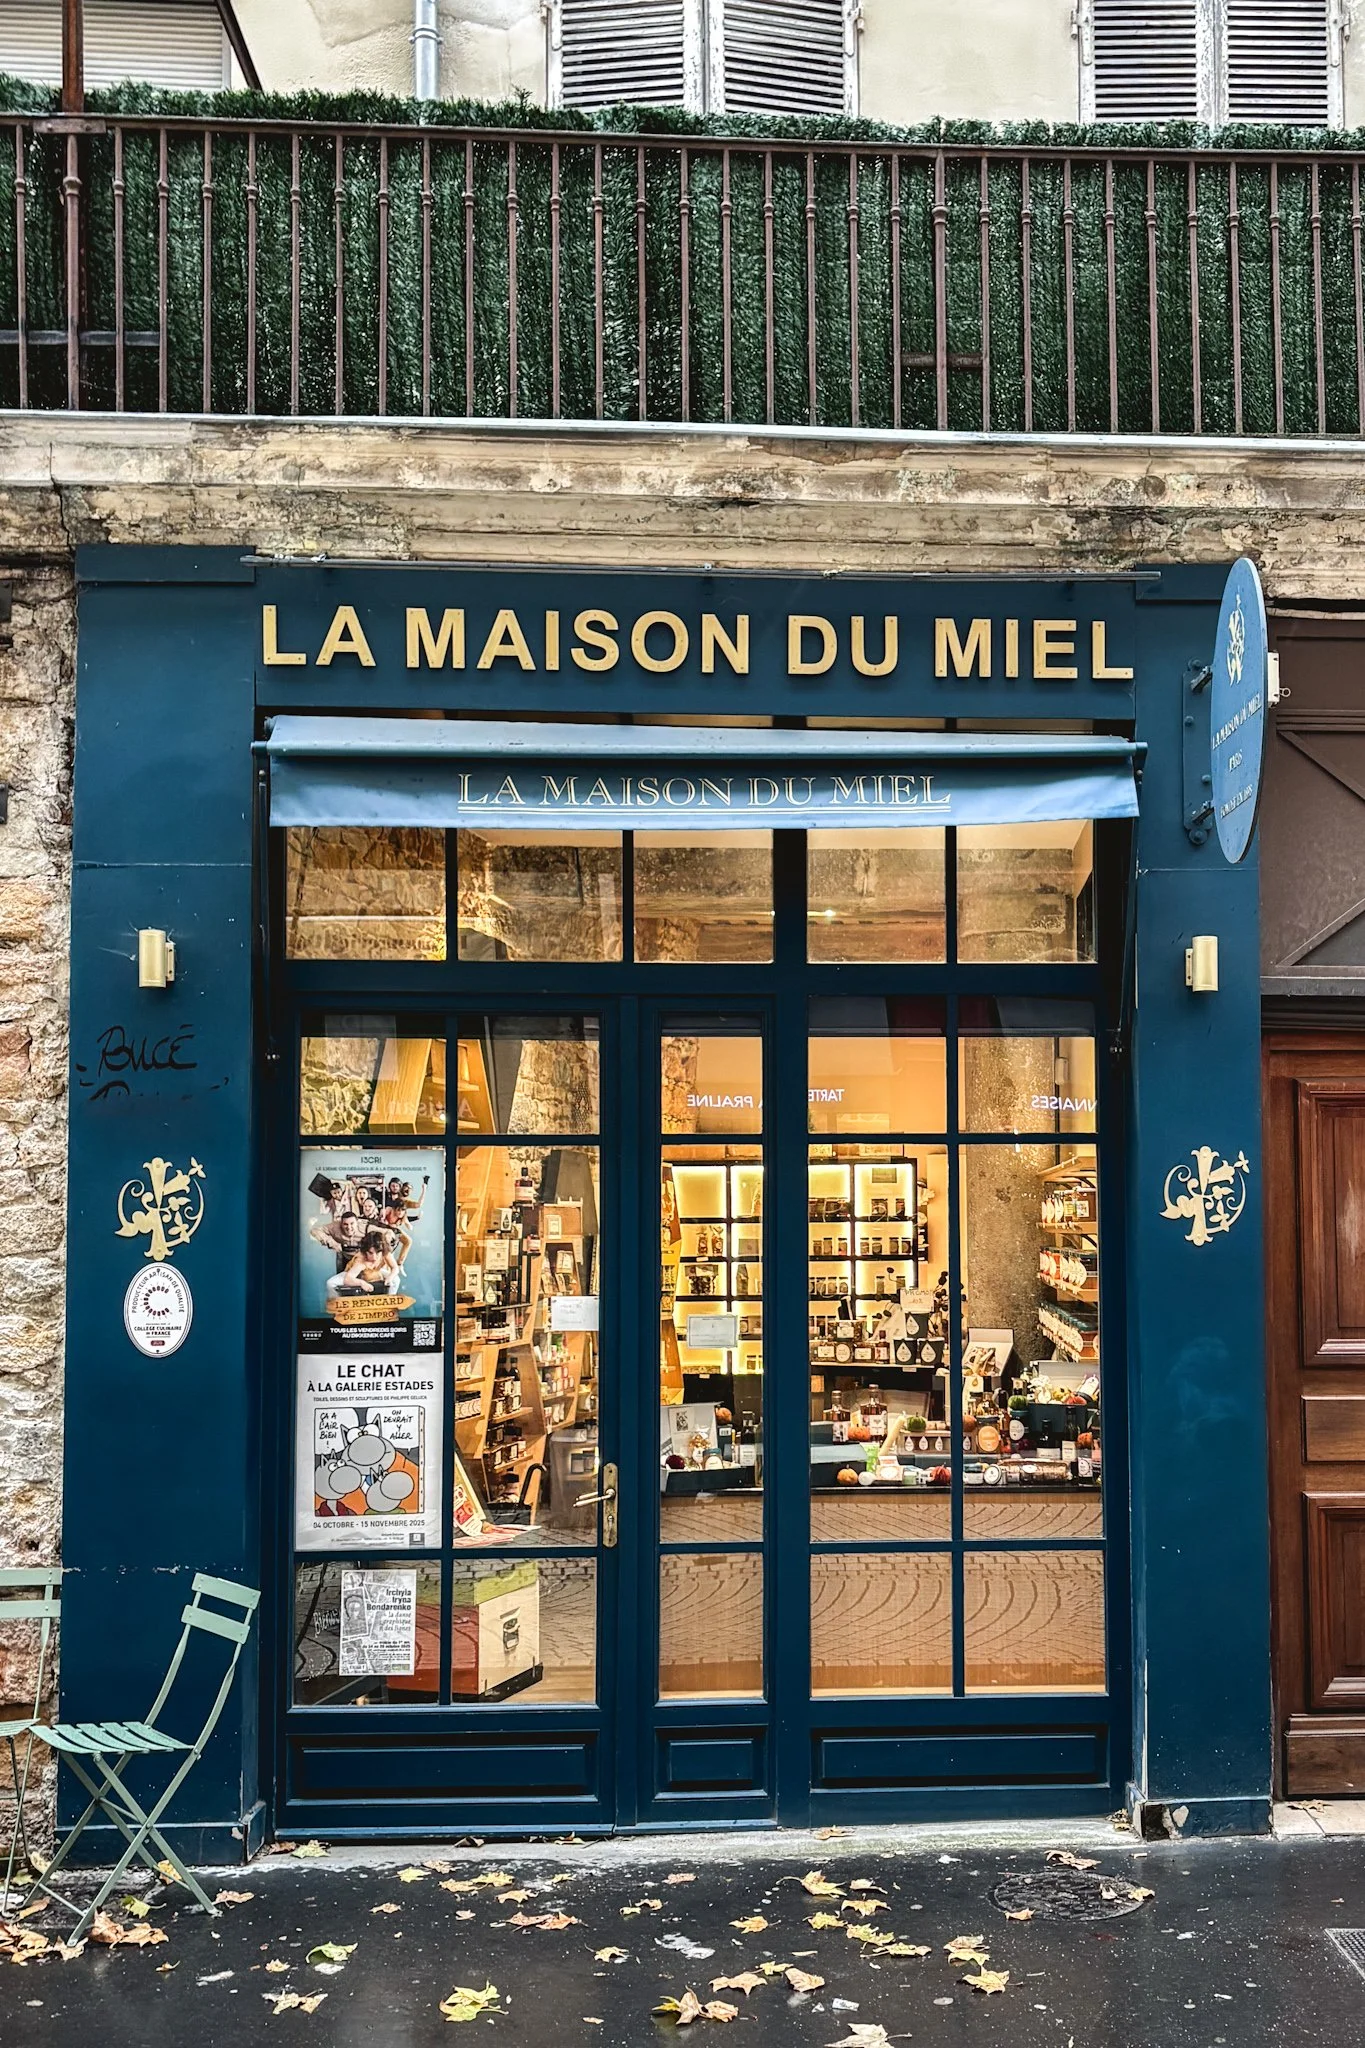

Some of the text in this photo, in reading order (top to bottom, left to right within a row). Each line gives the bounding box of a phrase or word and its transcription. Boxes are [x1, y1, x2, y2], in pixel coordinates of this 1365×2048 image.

[262, 604, 1134, 680] LA MAISON DU MIEL
[457, 774, 951, 806] LA MAISON DU MIEL
[335, 1297, 404, 1309] LE RENCARD
[337, 1364, 405, 1378] LE CHAT
[307, 1380, 434, 1392] À LA GALERIE ESTADES
[366, 1603, 412, 1611] Bondarenko
